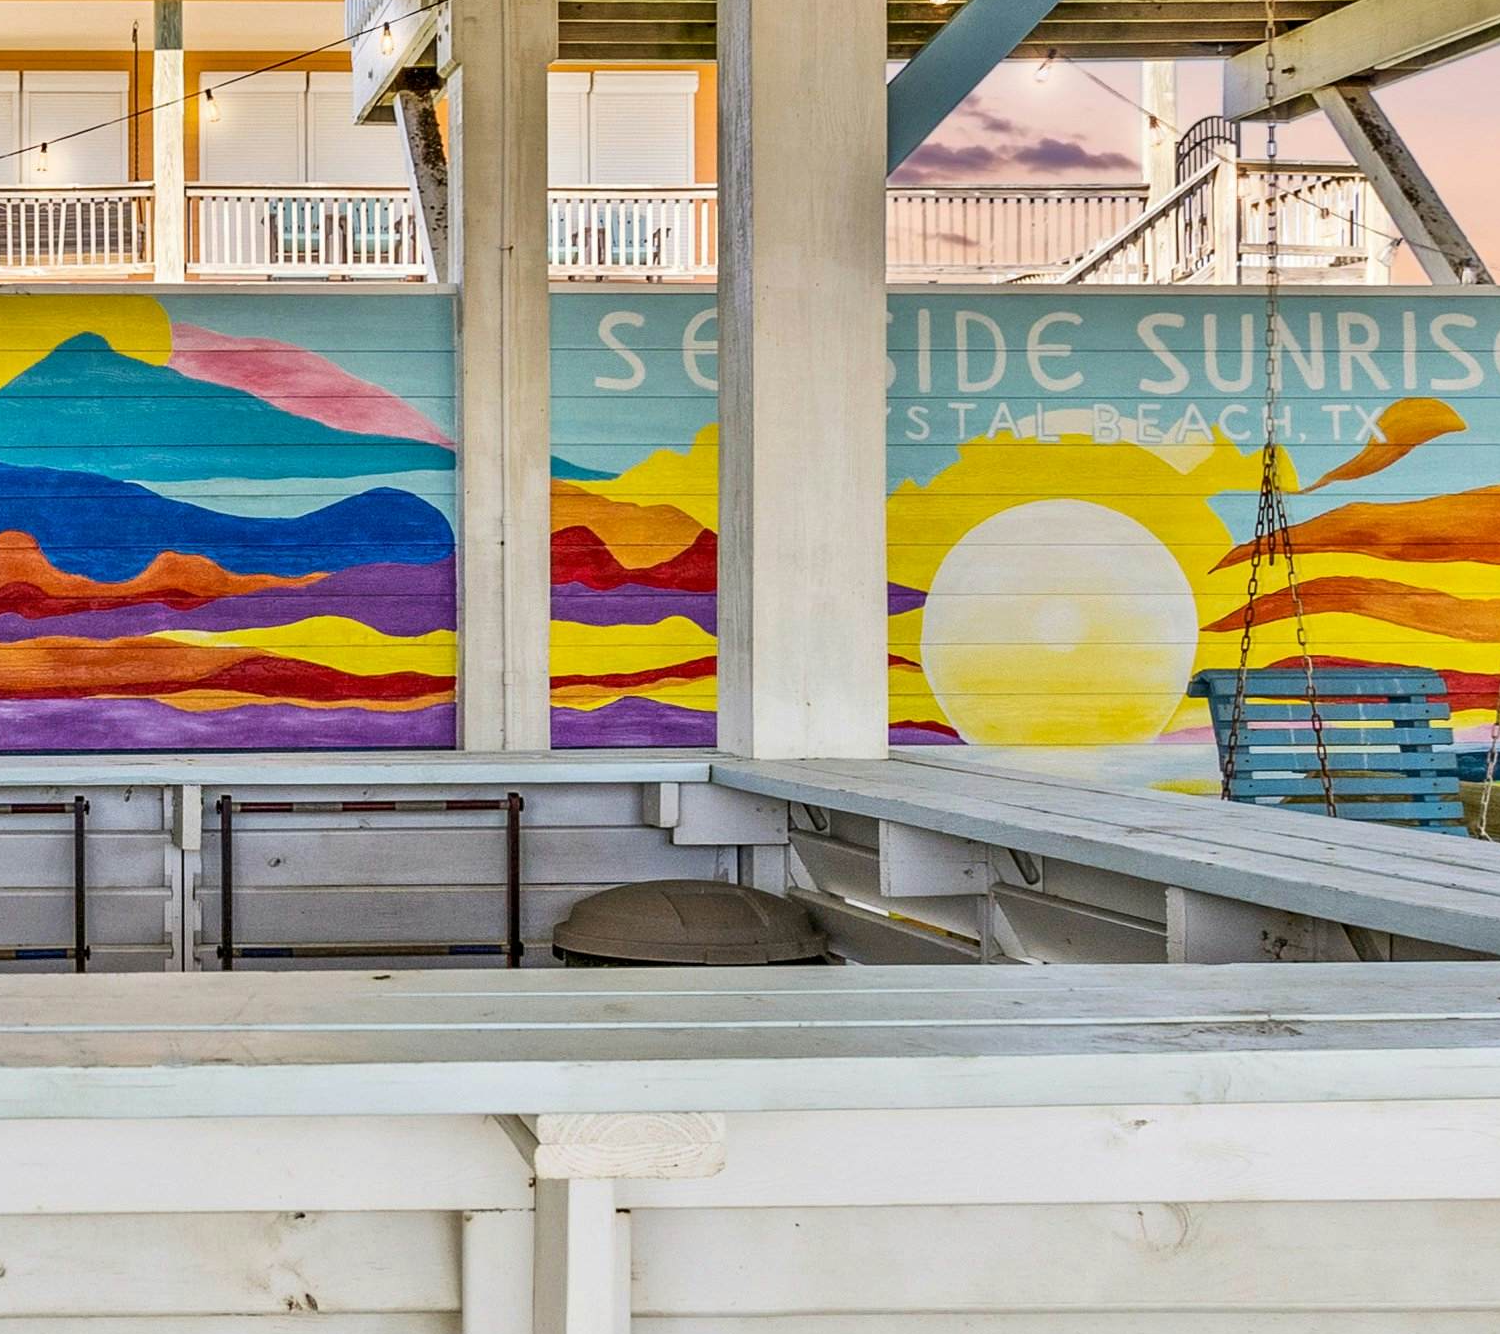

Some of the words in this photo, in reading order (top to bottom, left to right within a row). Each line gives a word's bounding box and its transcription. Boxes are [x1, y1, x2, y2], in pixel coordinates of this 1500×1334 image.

[595, 308, 1084, 394] SEIDE
[1093, 403, 1307, 445] BEACH,
[1321, 404, 1387, 444] TX
